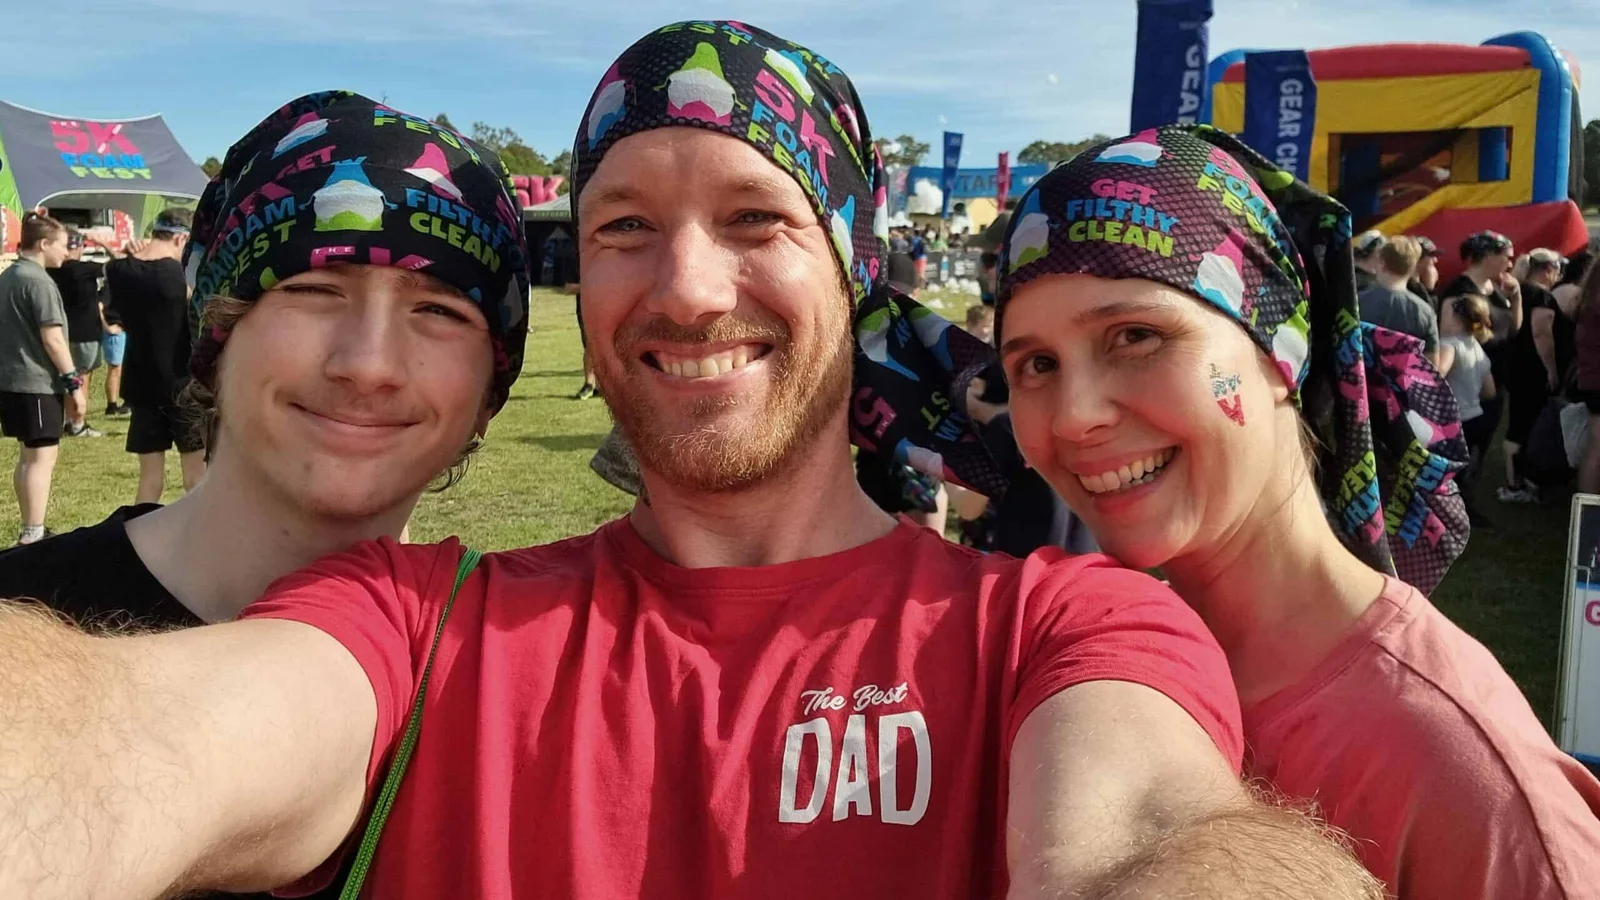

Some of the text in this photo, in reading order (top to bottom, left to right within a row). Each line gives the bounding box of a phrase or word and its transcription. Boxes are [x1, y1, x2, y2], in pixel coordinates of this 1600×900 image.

[660, 23, 749, 46] EST
[51, 121, 141, 155] 5K
[752, 68, 836, 188] 5K
[1275, 78, 1304, 174] GEAR CH
[60, 153, 146, 169] FOAM
[751, 99, 829, 209] FOAM
[70, 166, 152, 180] FEST
[1090, 178, 1157, 205] GET
[406, 187, 512, 249] FILTHY
[1067, 198, 1180, 233] FILTHY
[409, 212, 501, 274] CLEAN
[1068, 220, 1174, 258] CLEAN
[801, 682, 908, 715] The Best
[778, 711, 932, 826] DAD
